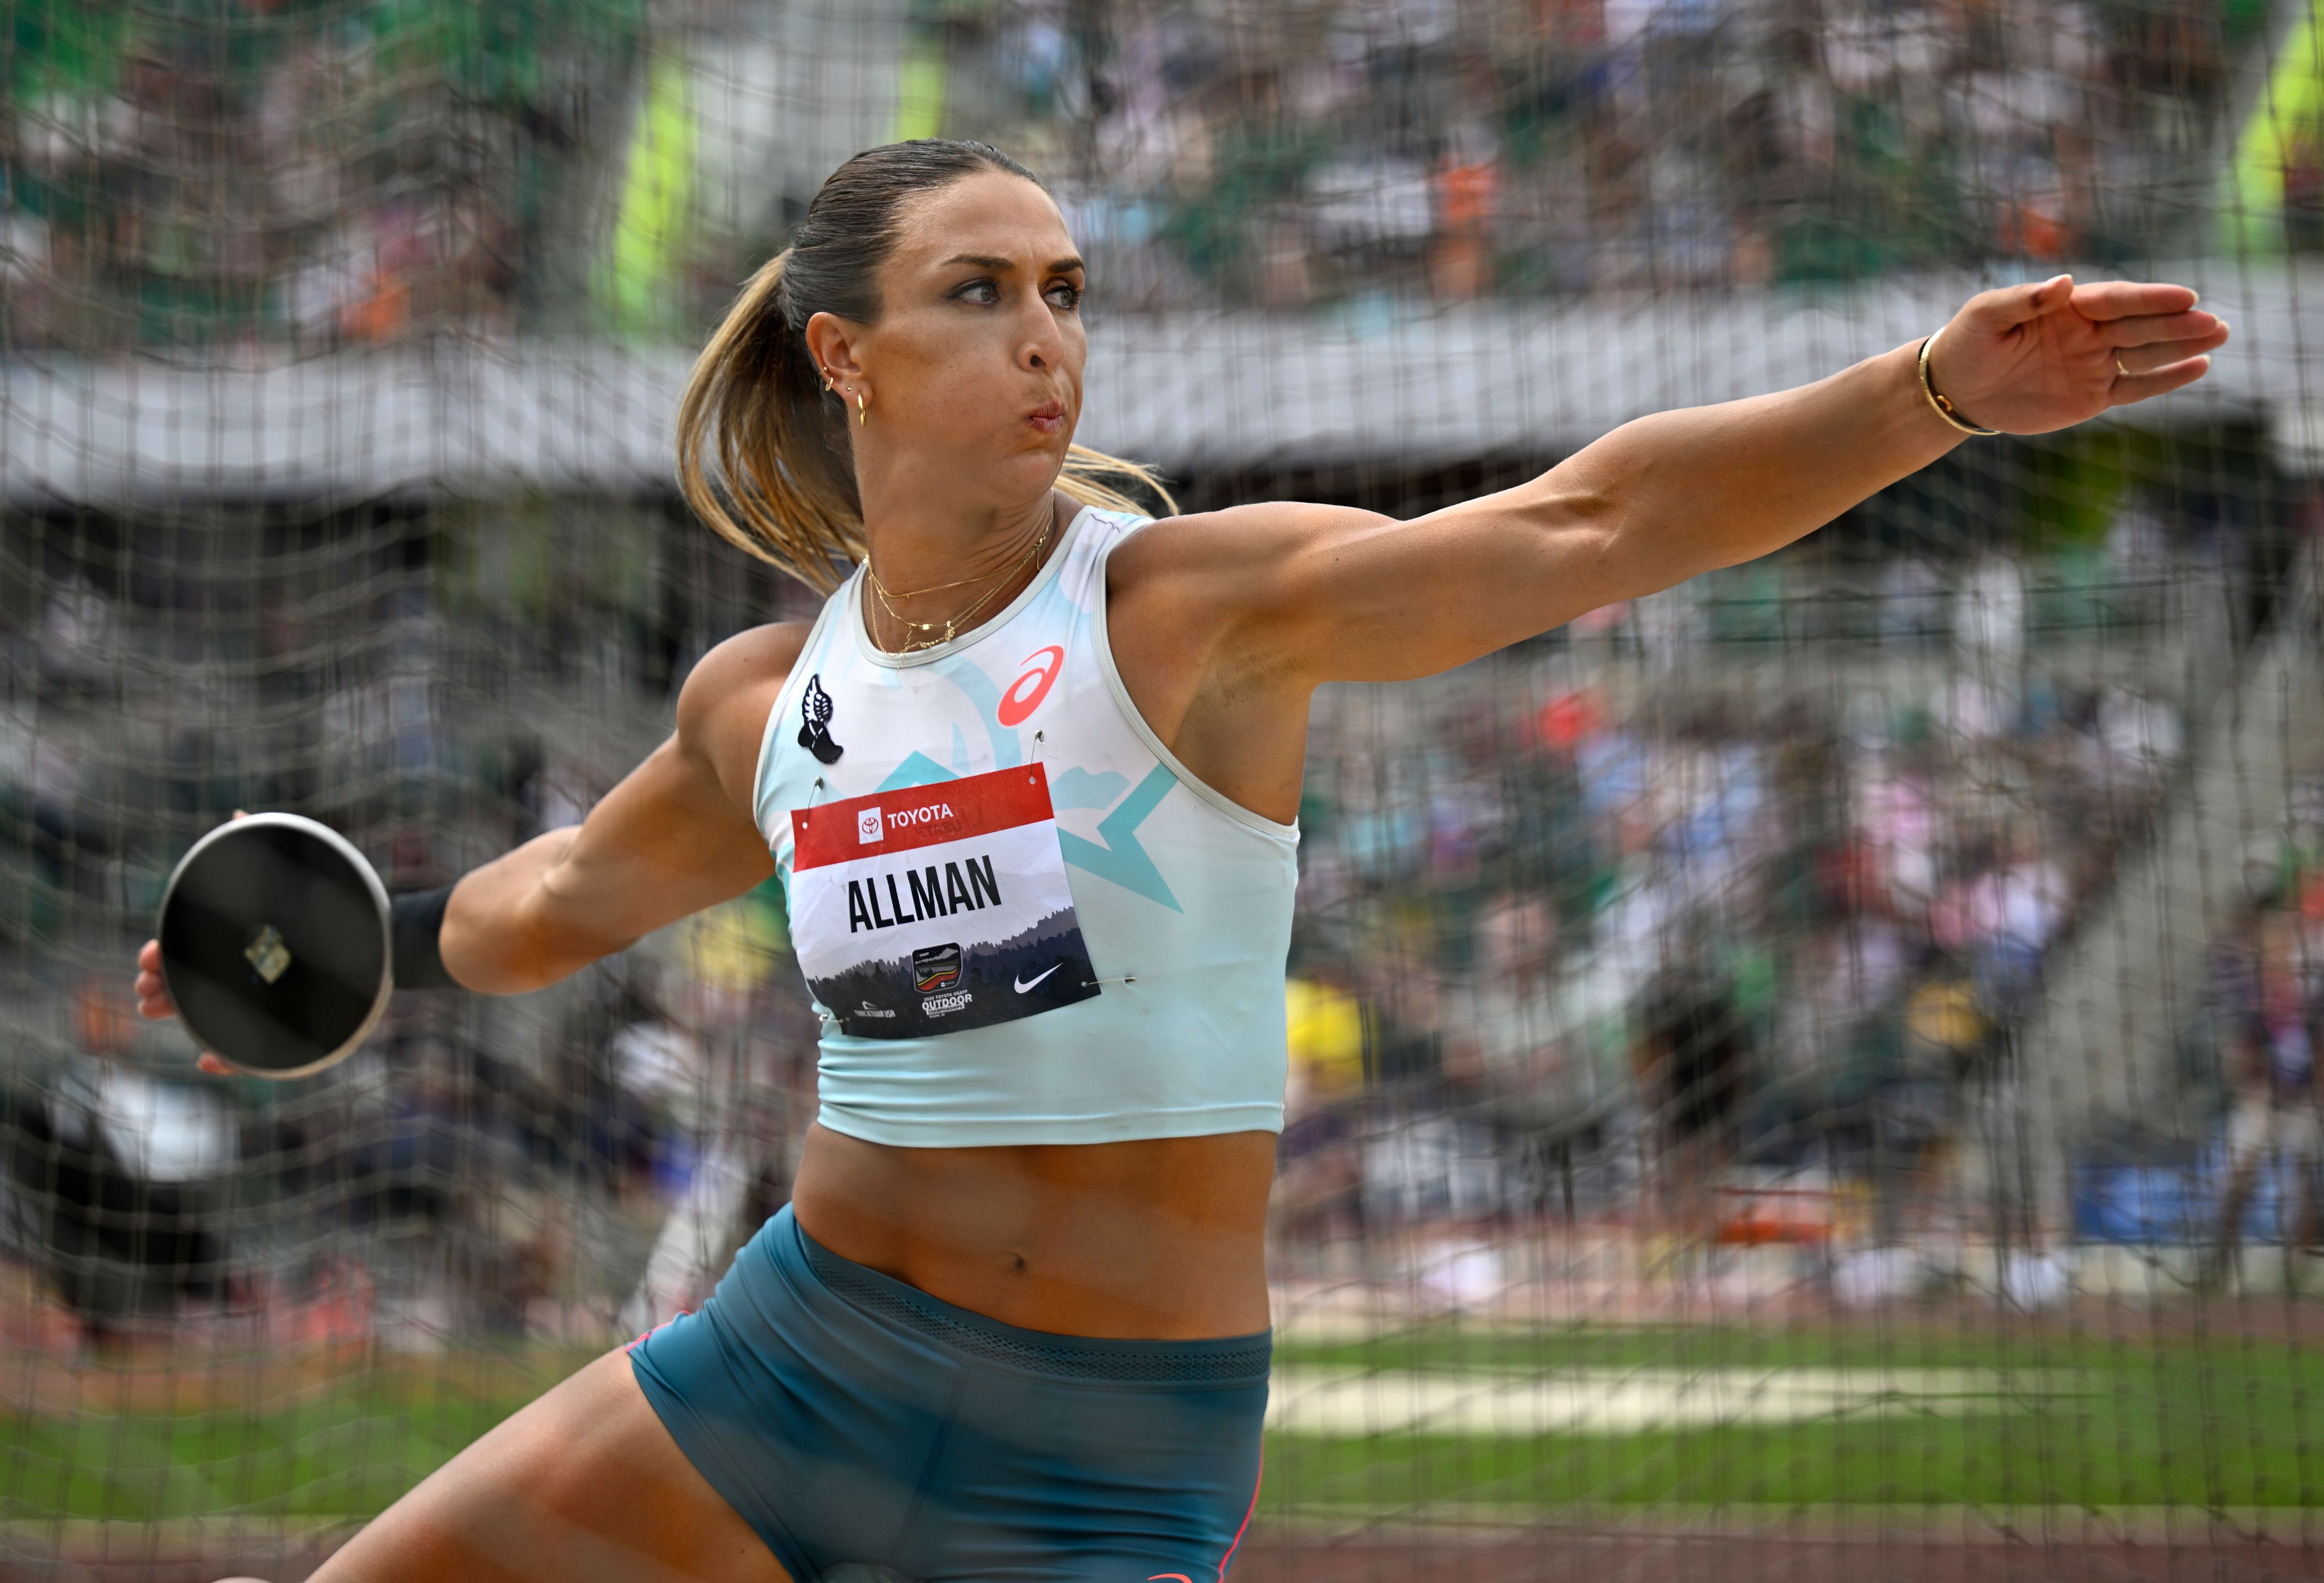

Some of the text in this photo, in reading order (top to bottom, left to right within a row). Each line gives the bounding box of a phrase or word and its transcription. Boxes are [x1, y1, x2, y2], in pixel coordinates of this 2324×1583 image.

[887, 804, 954, 829] TOYOTA
[848, 854, 1002, 933] ALLMAN
[921, 993, 973, 1011] OUTDOOR
[928, 1004, 963, 1013] CHAMPIONSHIPS
[883, 1009, 896, 1018] USA
